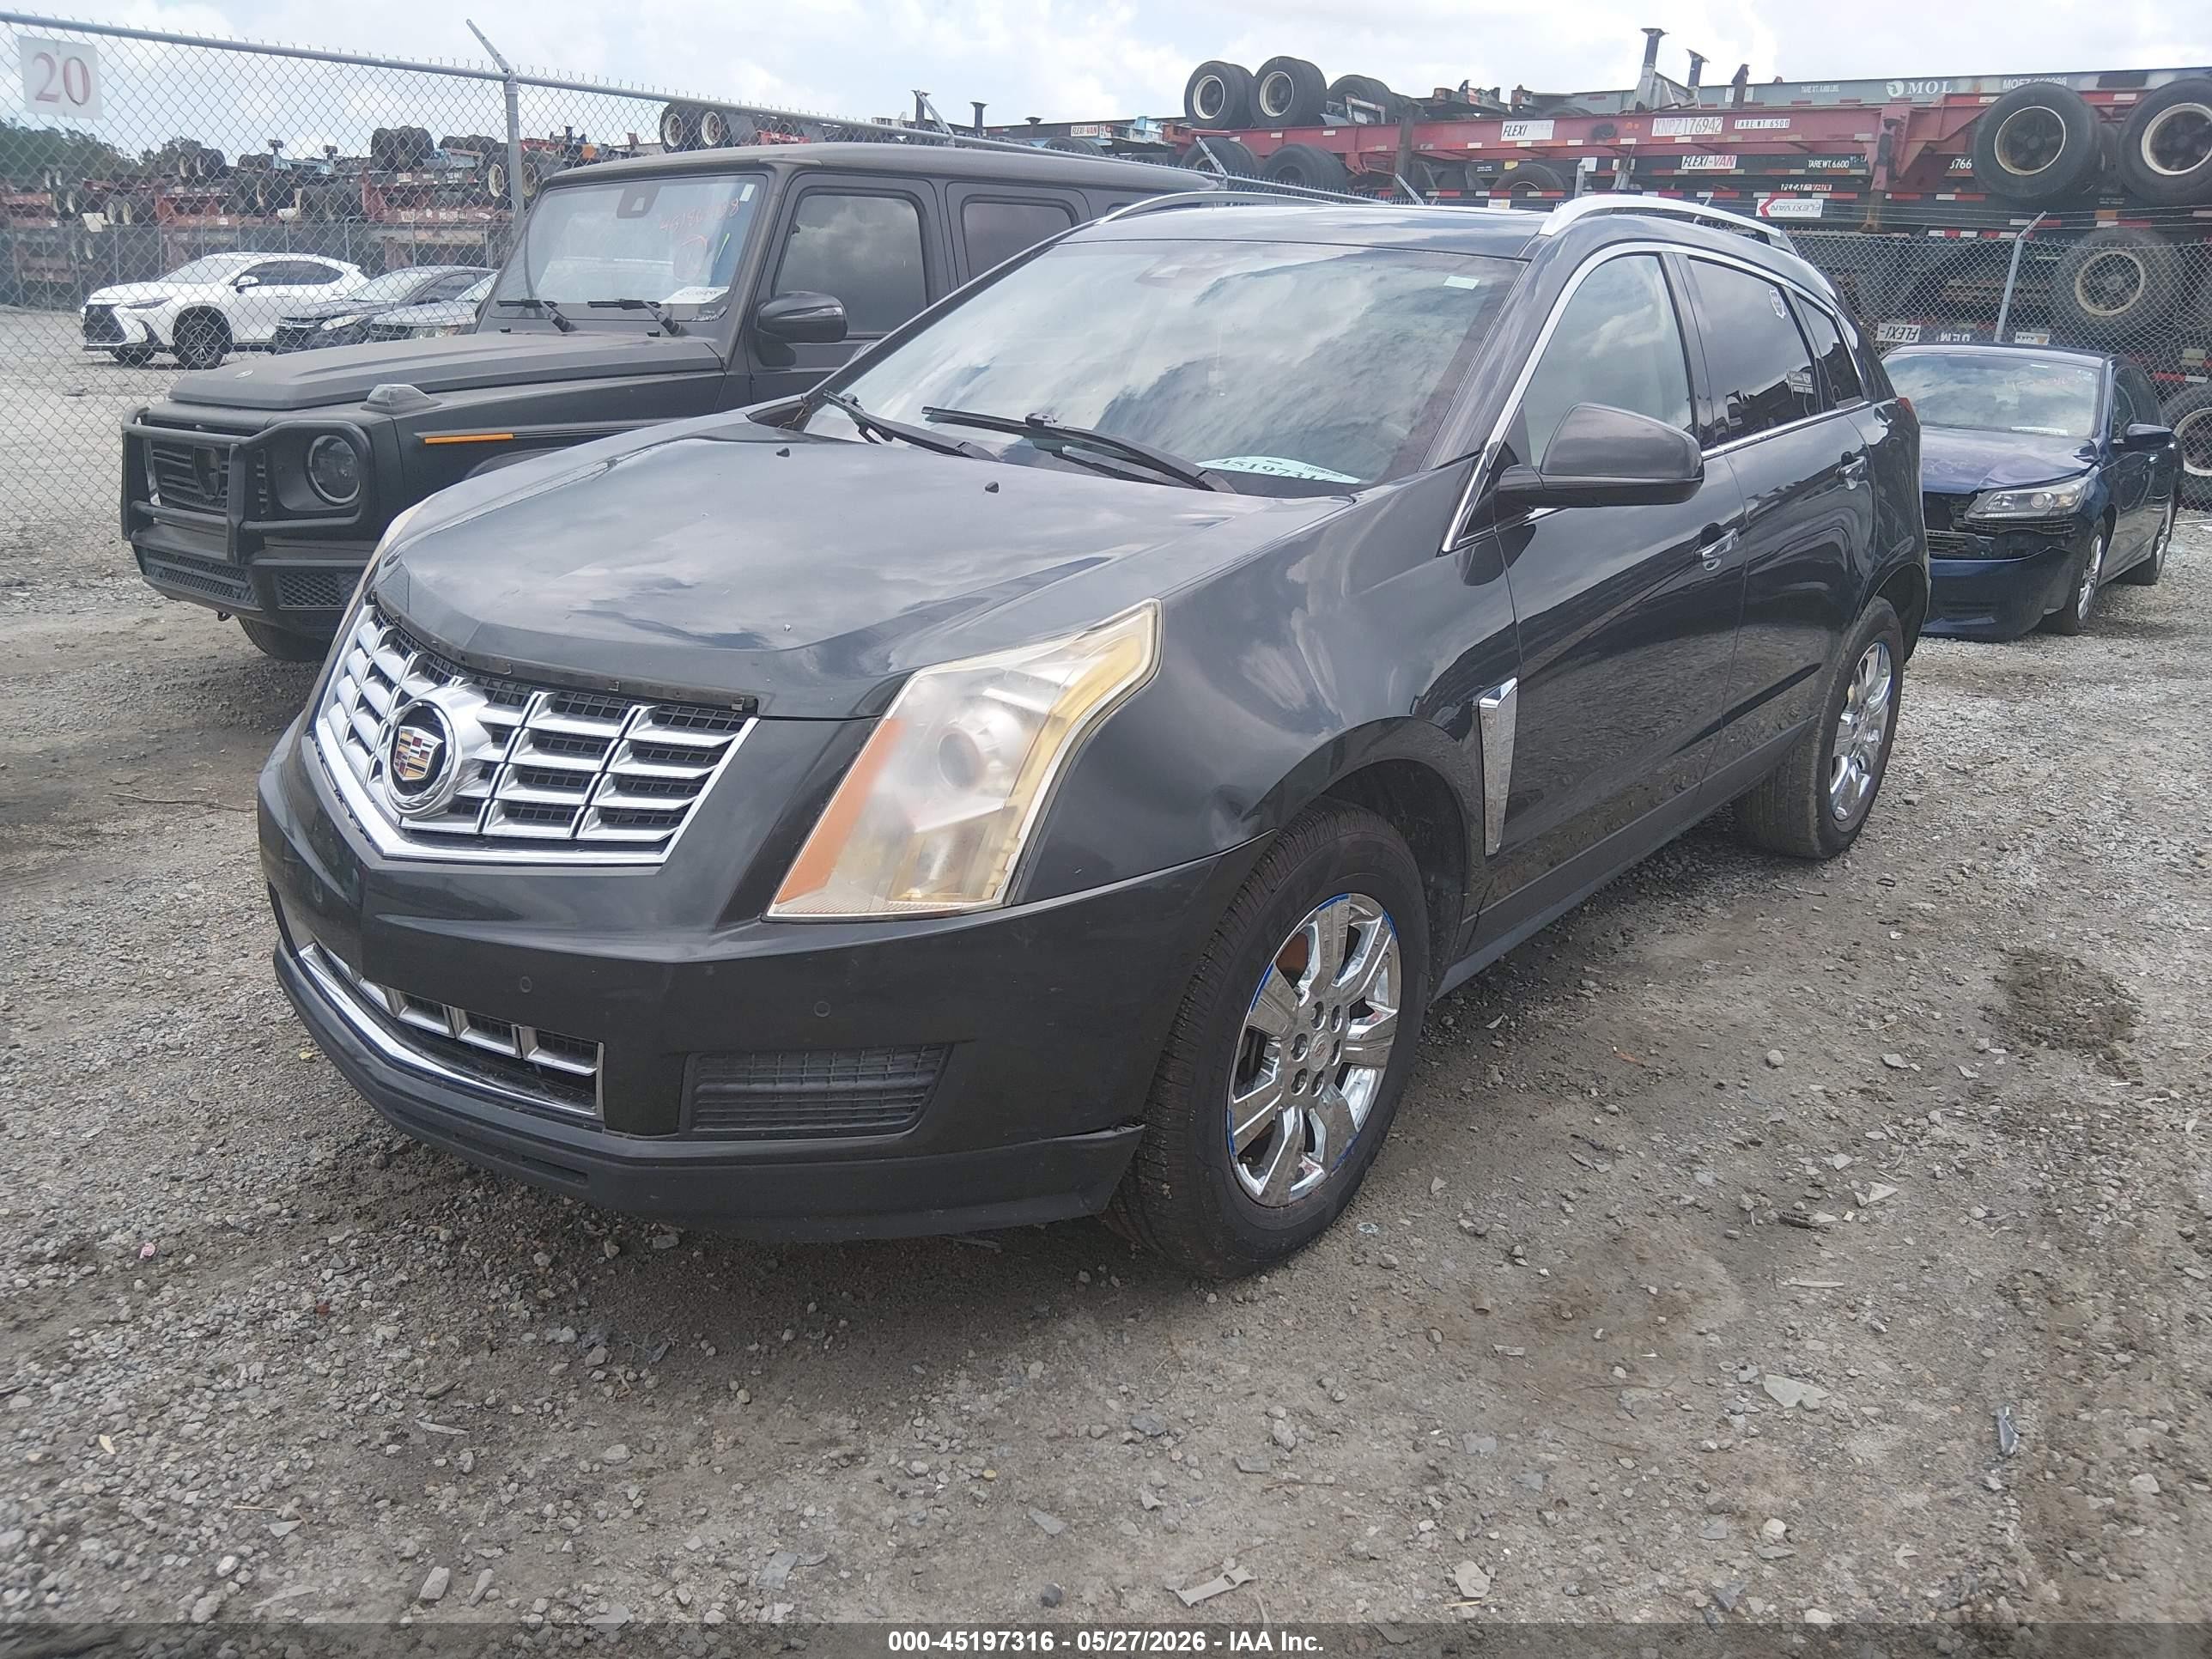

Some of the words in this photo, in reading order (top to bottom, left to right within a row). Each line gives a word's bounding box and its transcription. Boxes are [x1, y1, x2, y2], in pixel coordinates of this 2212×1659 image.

[33, 52, 91, 106] 20
[1907, 81, 1954, 94] MOL
[1503, 125, 1528, 137] FLEXI
[1683, 155, 1735, 167] FLEXI-VAN
